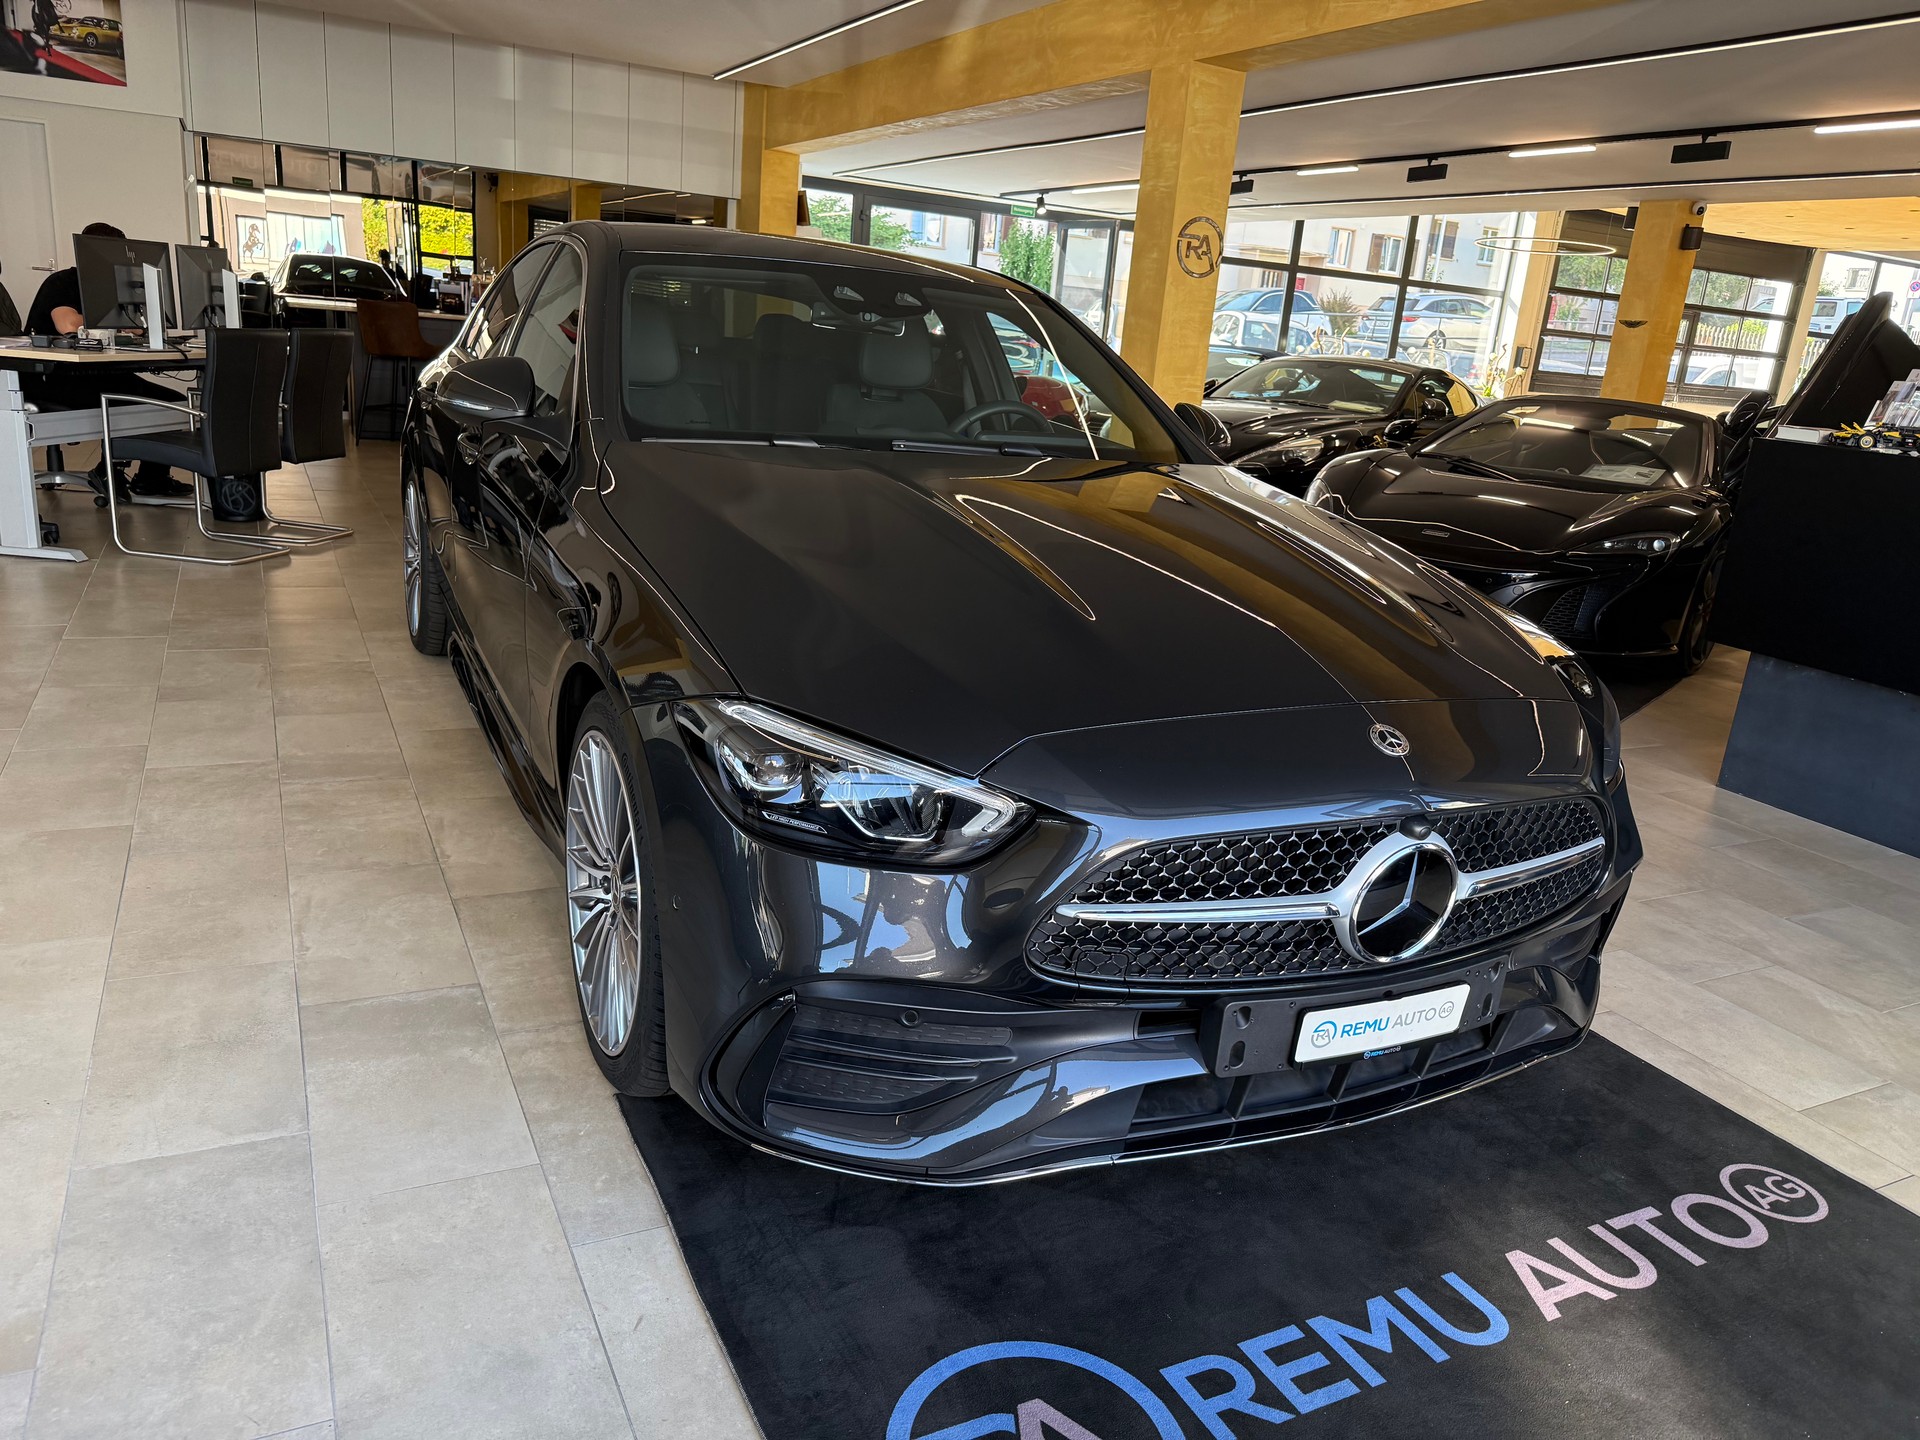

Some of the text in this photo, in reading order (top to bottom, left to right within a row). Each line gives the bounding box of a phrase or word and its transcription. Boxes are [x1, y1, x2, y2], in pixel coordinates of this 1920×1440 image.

[1340, 1016, 1390, 1038] REMU
[1392, 1007, 1437, 1029] AUTO
[1158, 1175, 1807, 1440] REMU AUTO AG
